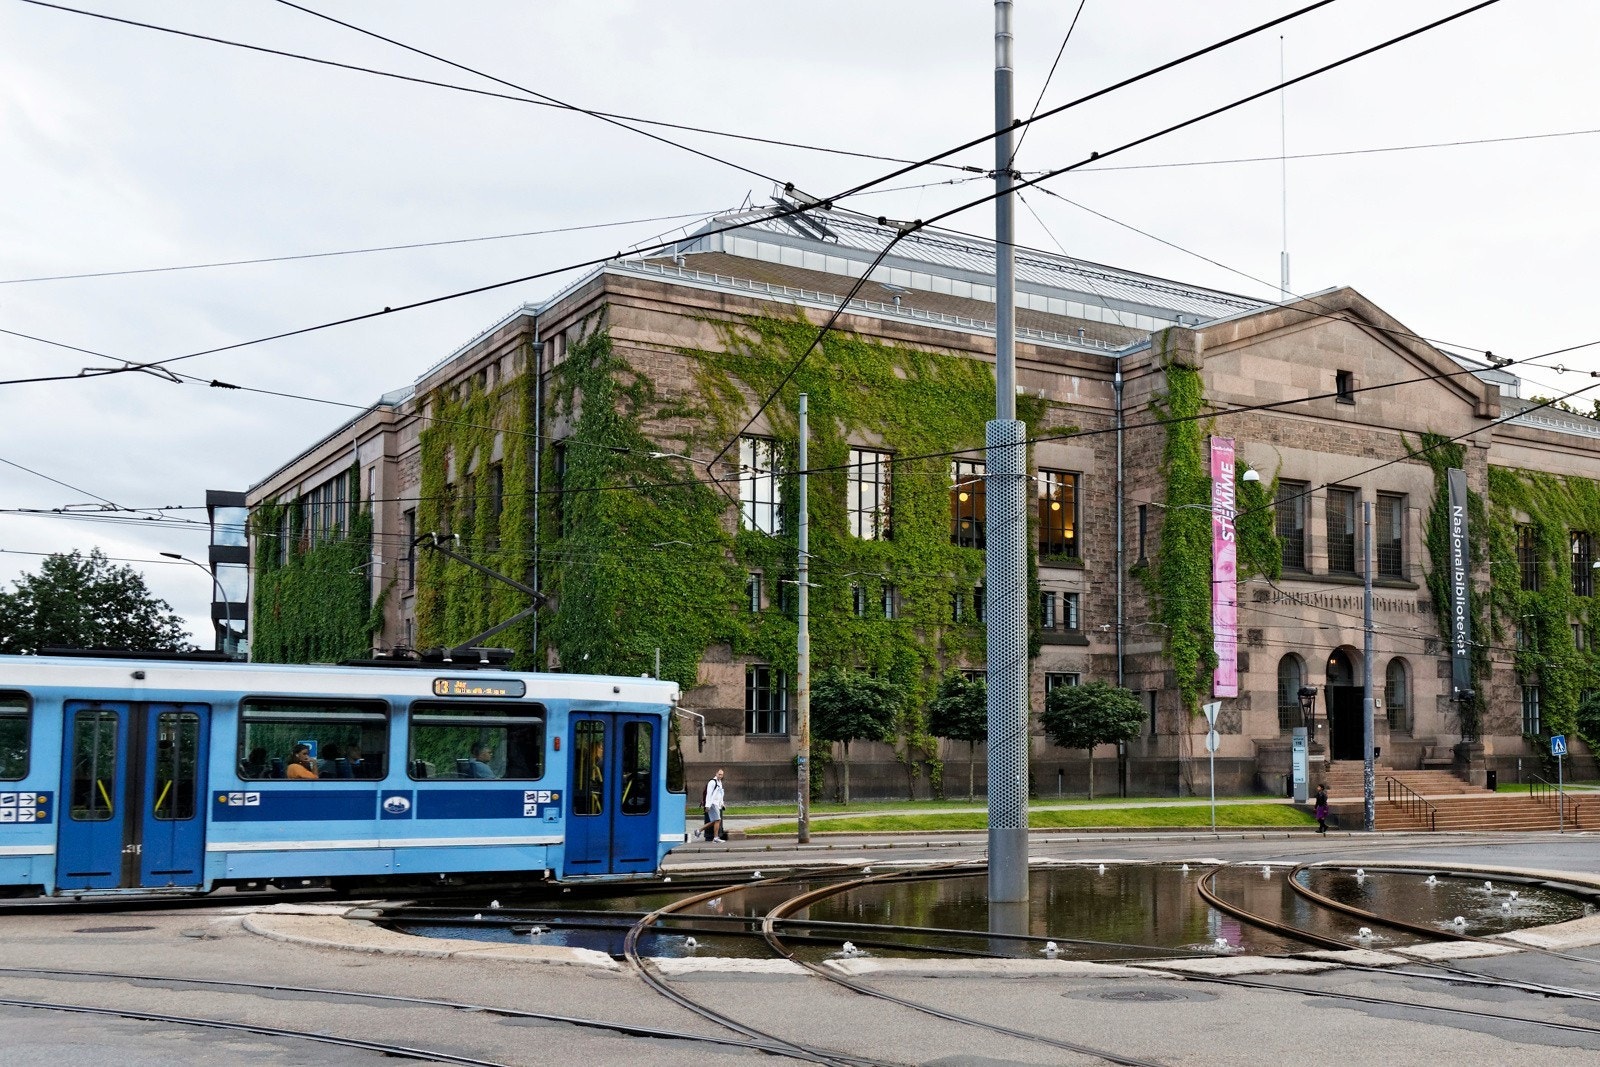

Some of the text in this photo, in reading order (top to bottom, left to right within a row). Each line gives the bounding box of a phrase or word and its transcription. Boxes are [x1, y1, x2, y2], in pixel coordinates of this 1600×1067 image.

[1221, 461, 1235, 543] STEMME
[1452, 505, 1466, 656] Nasjonalbiblioteket
[435, 680, 449, 694] 13
